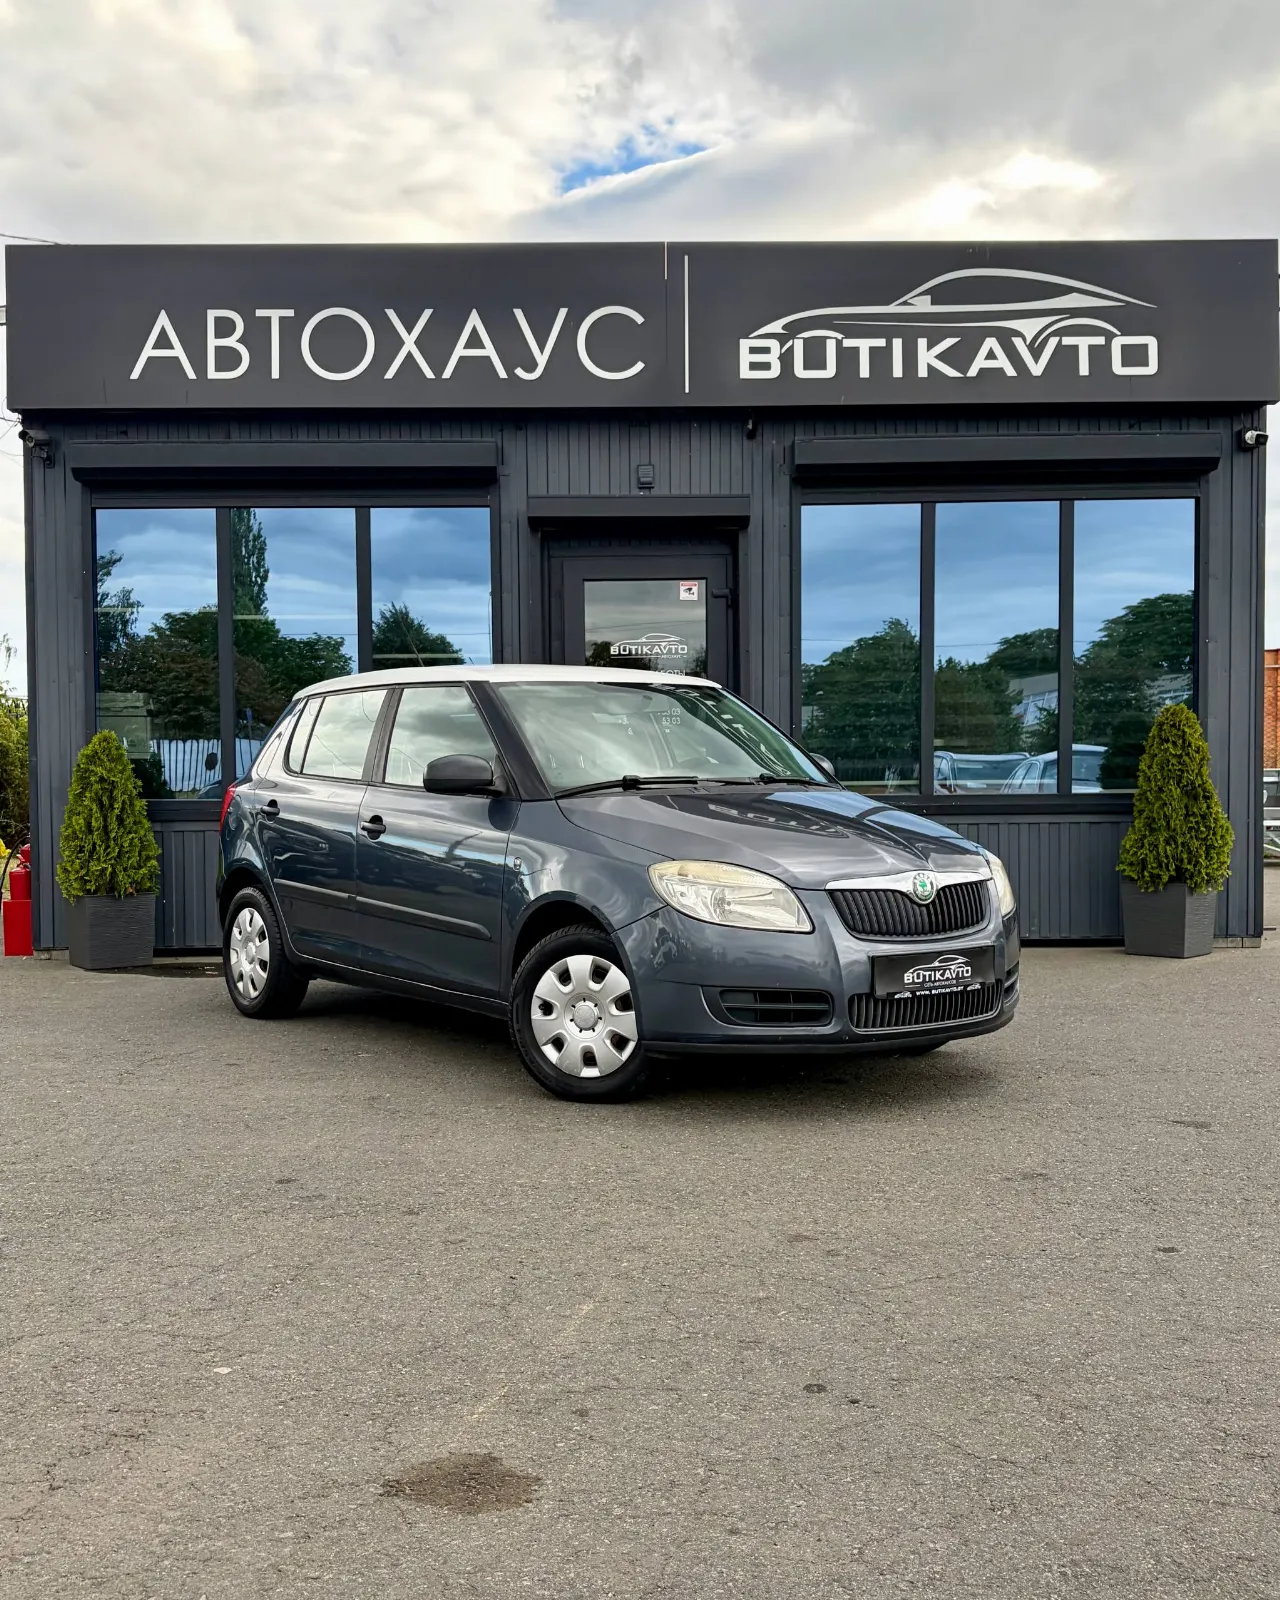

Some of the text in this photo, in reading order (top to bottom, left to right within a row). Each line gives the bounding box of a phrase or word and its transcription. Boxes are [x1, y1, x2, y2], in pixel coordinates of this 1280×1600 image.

[130, 306, 645, 381] АВТОХАУС
[739, 335, 1159, 379] BUTIKAVTO
[610, 645, 688, 654] BUTIKAVTO
[904, 966, 972, 983] BUTIKAVTO
